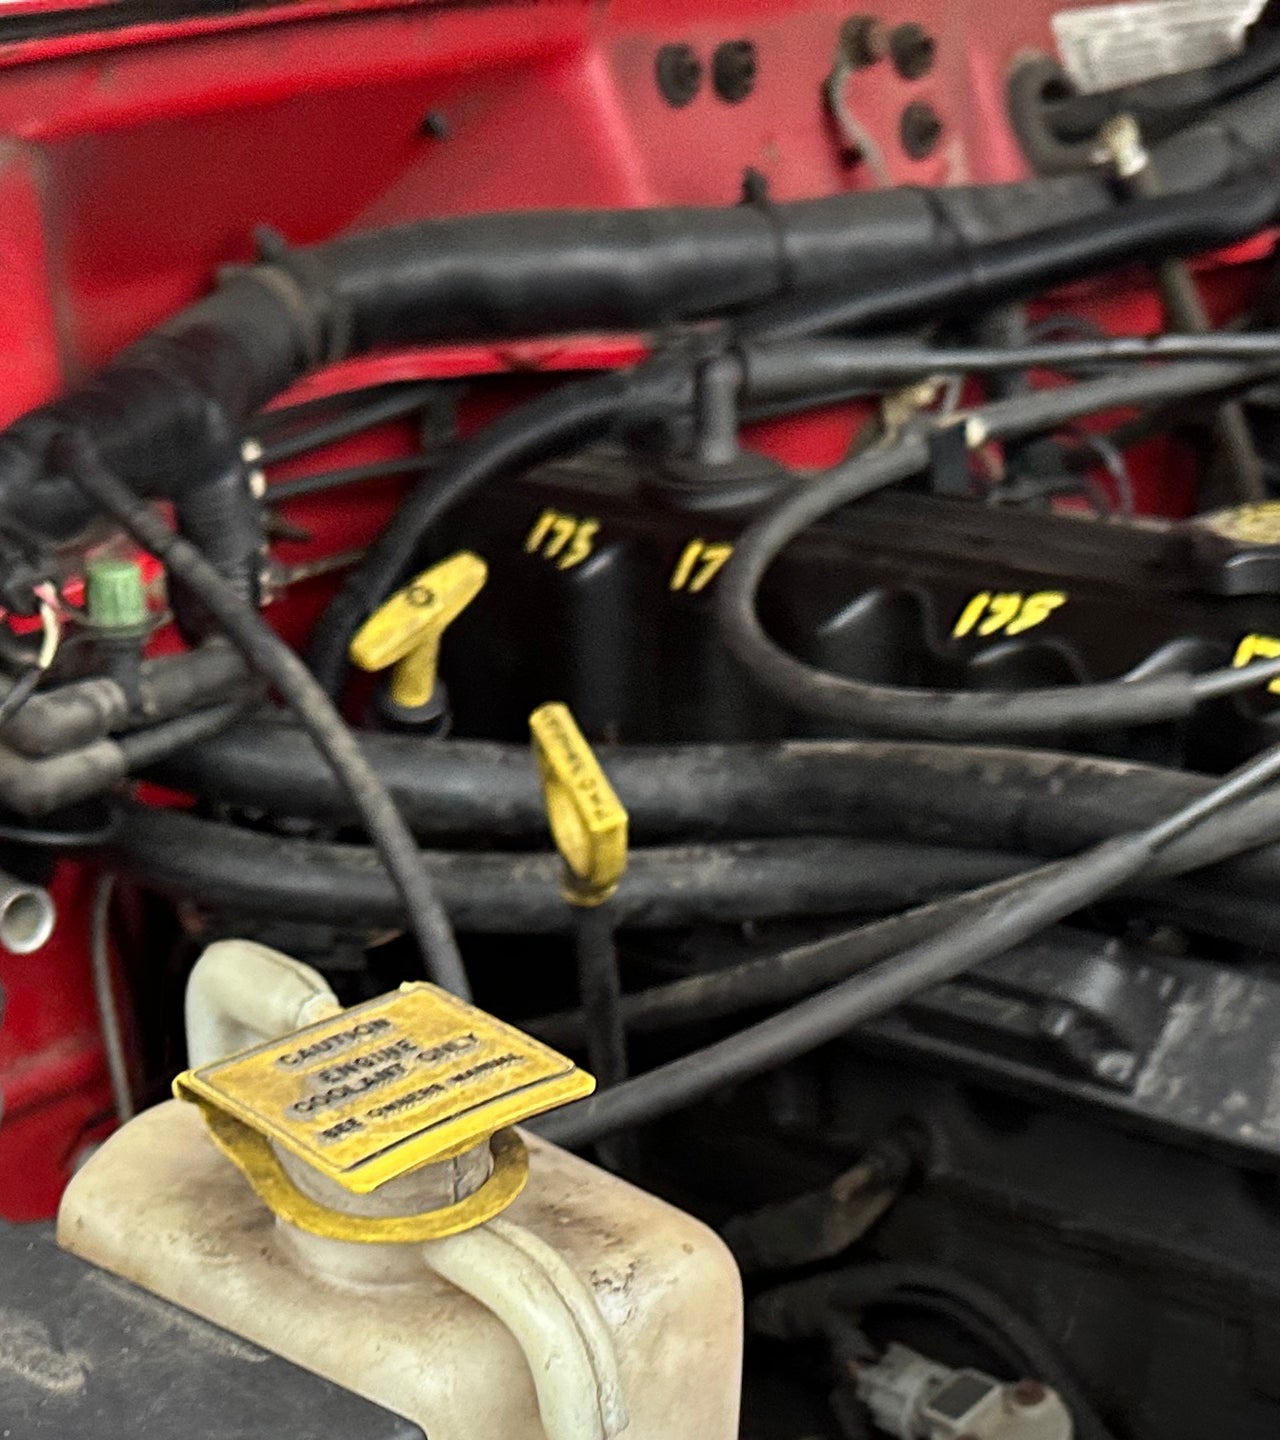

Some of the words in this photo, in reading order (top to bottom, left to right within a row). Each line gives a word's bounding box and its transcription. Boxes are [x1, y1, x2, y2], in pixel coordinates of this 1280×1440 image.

[273, 1017, 393, 1066] CAUTION
[312, 1038, 421, 1085] ENGINE
[288, 1062, 409, 1114] COOLANT
